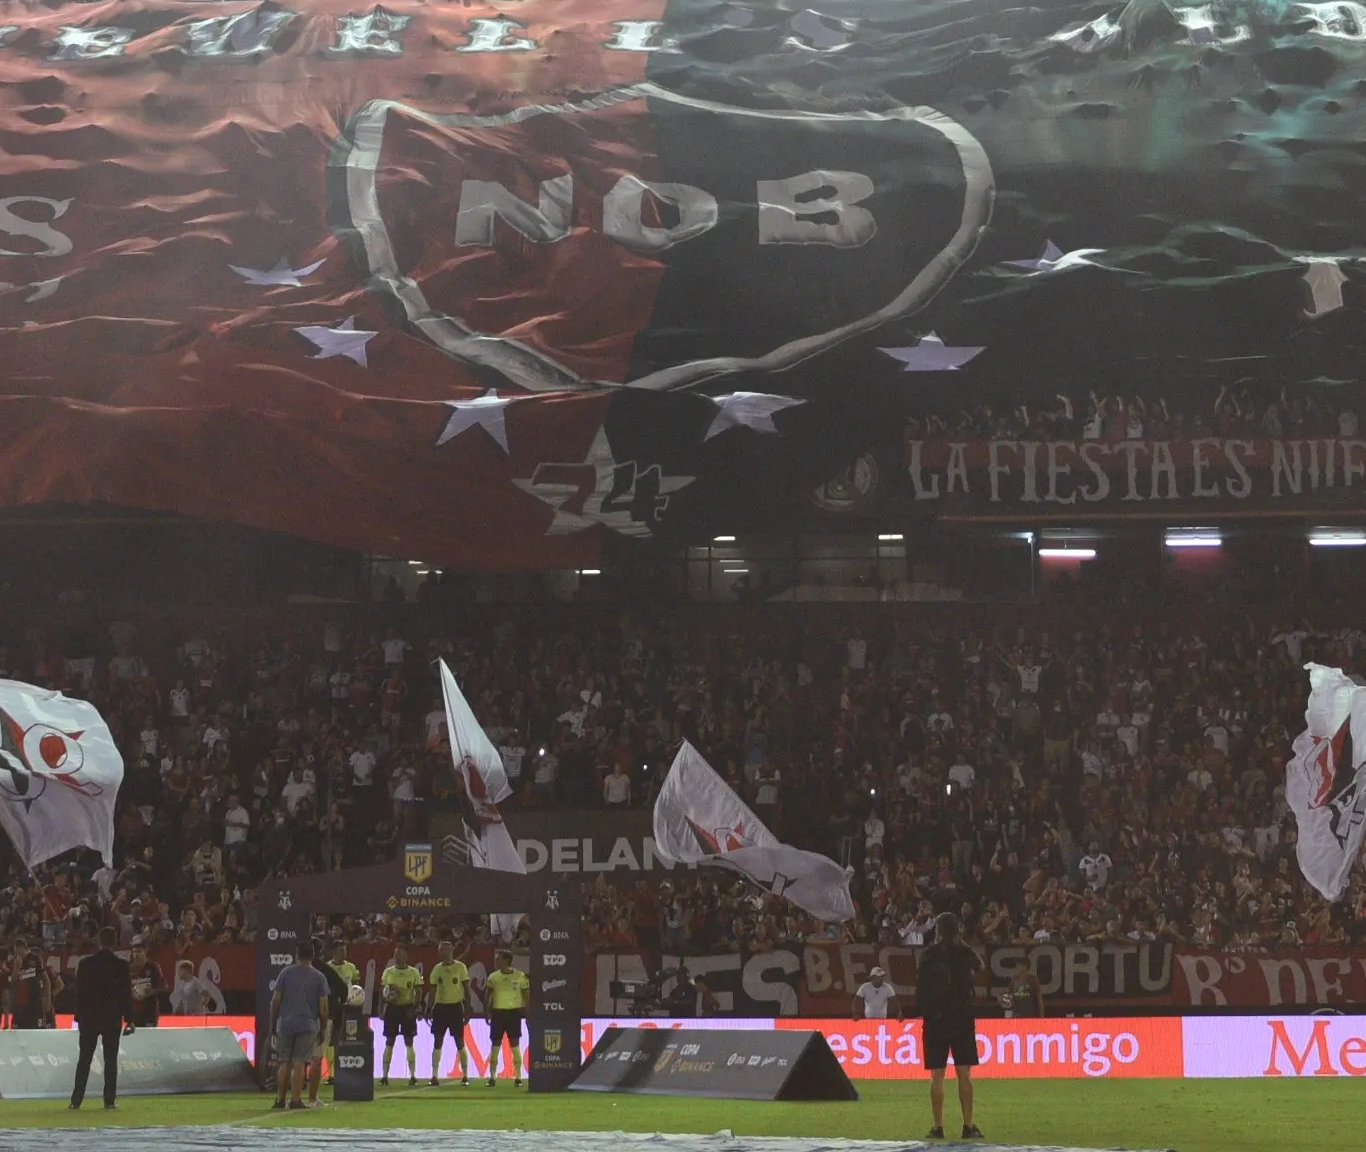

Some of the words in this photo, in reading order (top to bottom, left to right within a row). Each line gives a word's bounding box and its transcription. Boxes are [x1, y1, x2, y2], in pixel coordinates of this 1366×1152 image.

[454, 169, 879, 252] NOB
[908, 439, 970, 501] LA
[988, 439, 1180, 505] FIESTA
[405, 885, 432, 896] COPA
[399, 897, 452, 908] BINANCE
[542, 1001, 566, 1012] TCL
